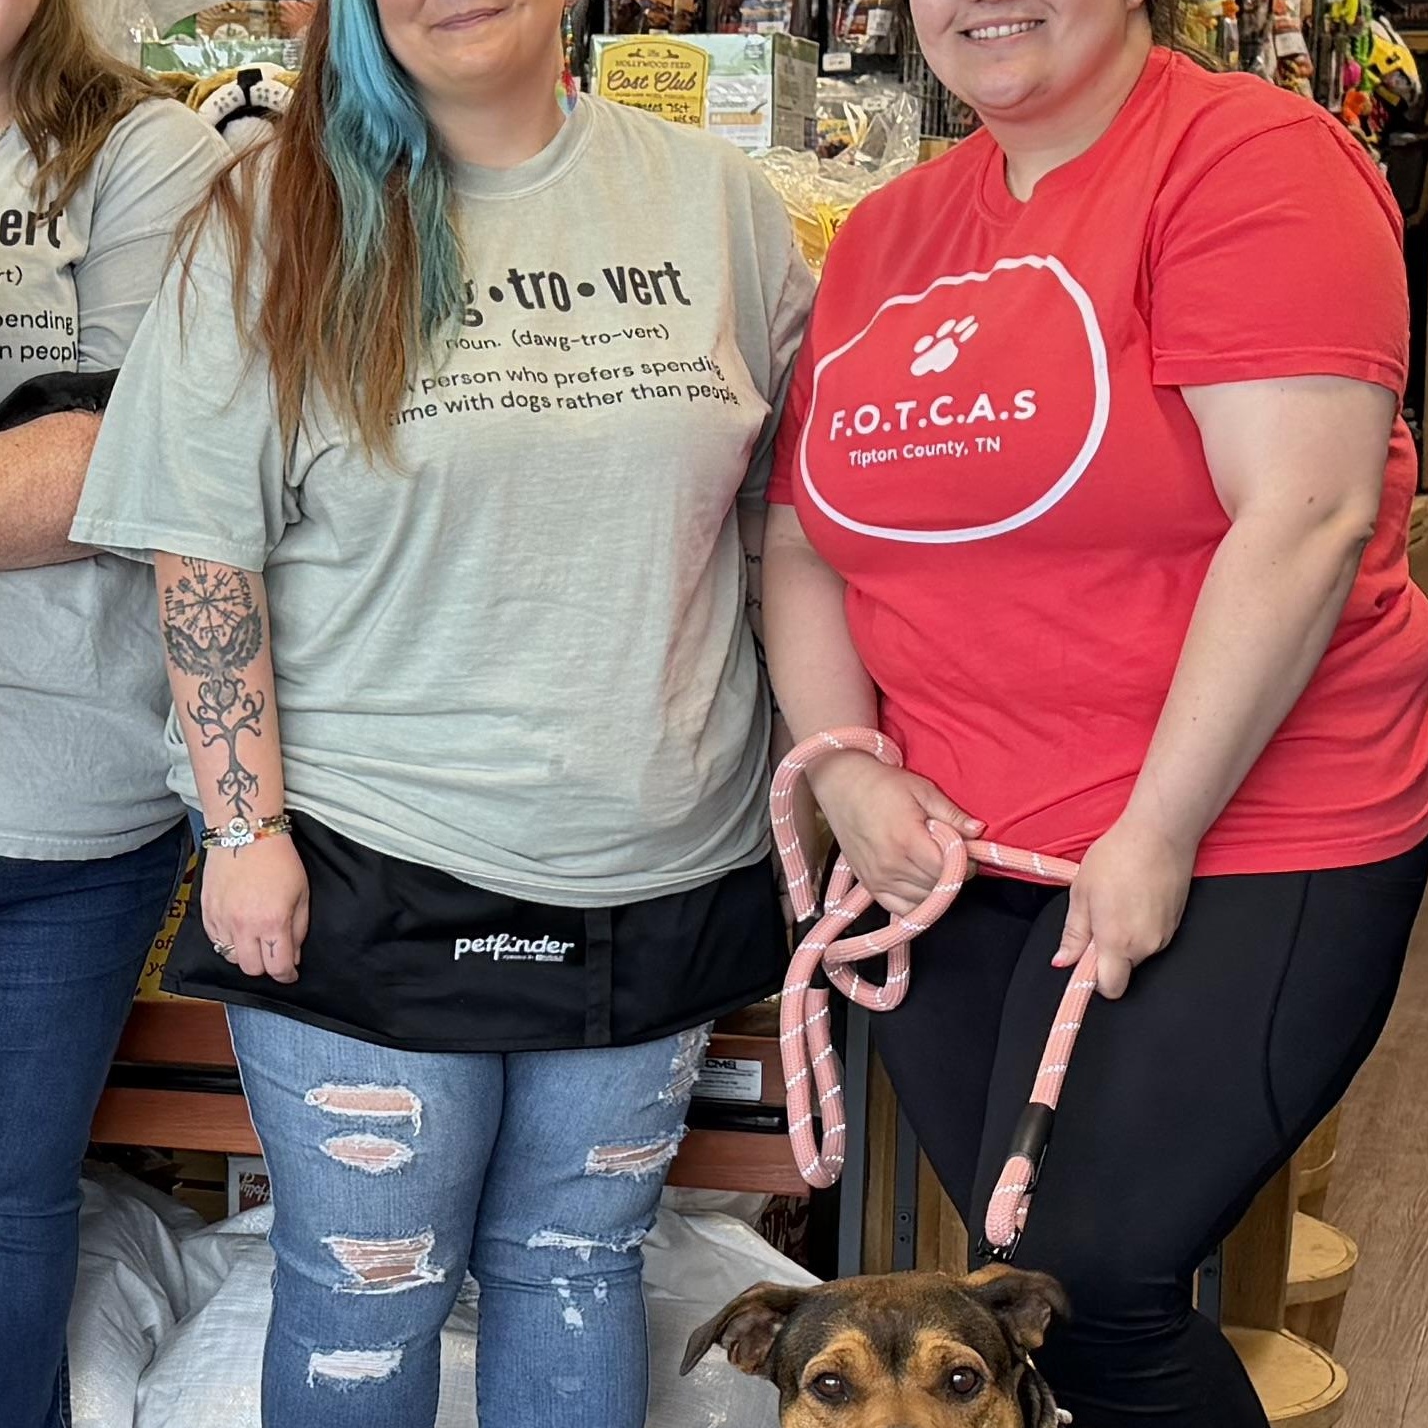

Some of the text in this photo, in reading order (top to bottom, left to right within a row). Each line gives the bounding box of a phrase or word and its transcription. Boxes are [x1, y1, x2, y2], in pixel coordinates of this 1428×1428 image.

[607, 69, 696, 92] Cost Club
[21, 341, 80, 363] peopl
[512, 323, 670, 353] (dawg-tro-vert)
[421, 370, 501, 395] person
[505, 366, 548, 384] who
[553, 361, 635, 388] prefers
[444, 392, 494, 414] with
[500, 389, 552, 414] dogs
[556, 388, 624, 411] rather
[630, 383, 682, 402] than
[829, 388, 1037, 441] F.O.T.C.A.S
[849, 435, 1001, 468] Tipton County, TN
[454, 933, 575, 961] petfinder
